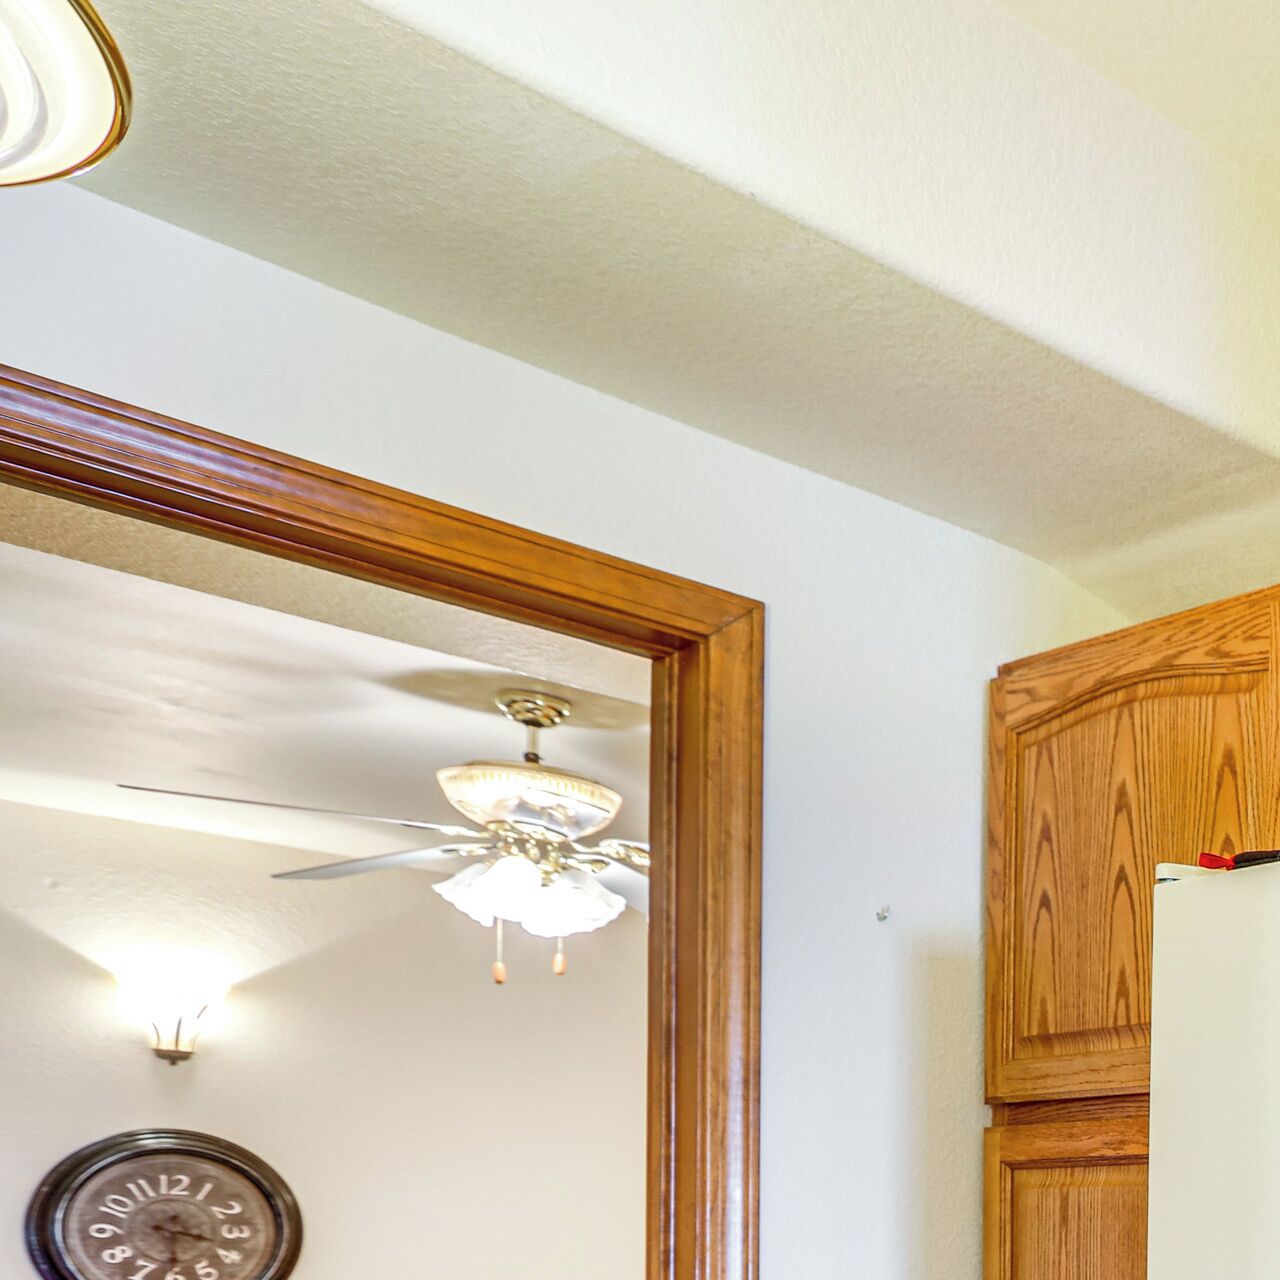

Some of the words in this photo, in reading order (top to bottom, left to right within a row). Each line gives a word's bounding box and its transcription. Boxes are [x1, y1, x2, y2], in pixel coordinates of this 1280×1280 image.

[126, 1179, 157, 1201] 11
[158, 1174, 191, 1195] 12
[196, 1182, 214, 1200] 1
[99, 1194, 135, 1219] 10
[211, 1201, 242, 1219] 2
[88, 1222, 125, 1239] 9
[221, 1224, 251, 1239] 3
[102, 1245, 133, 1264] 8
[216, 1248, 243, 1264] 4
